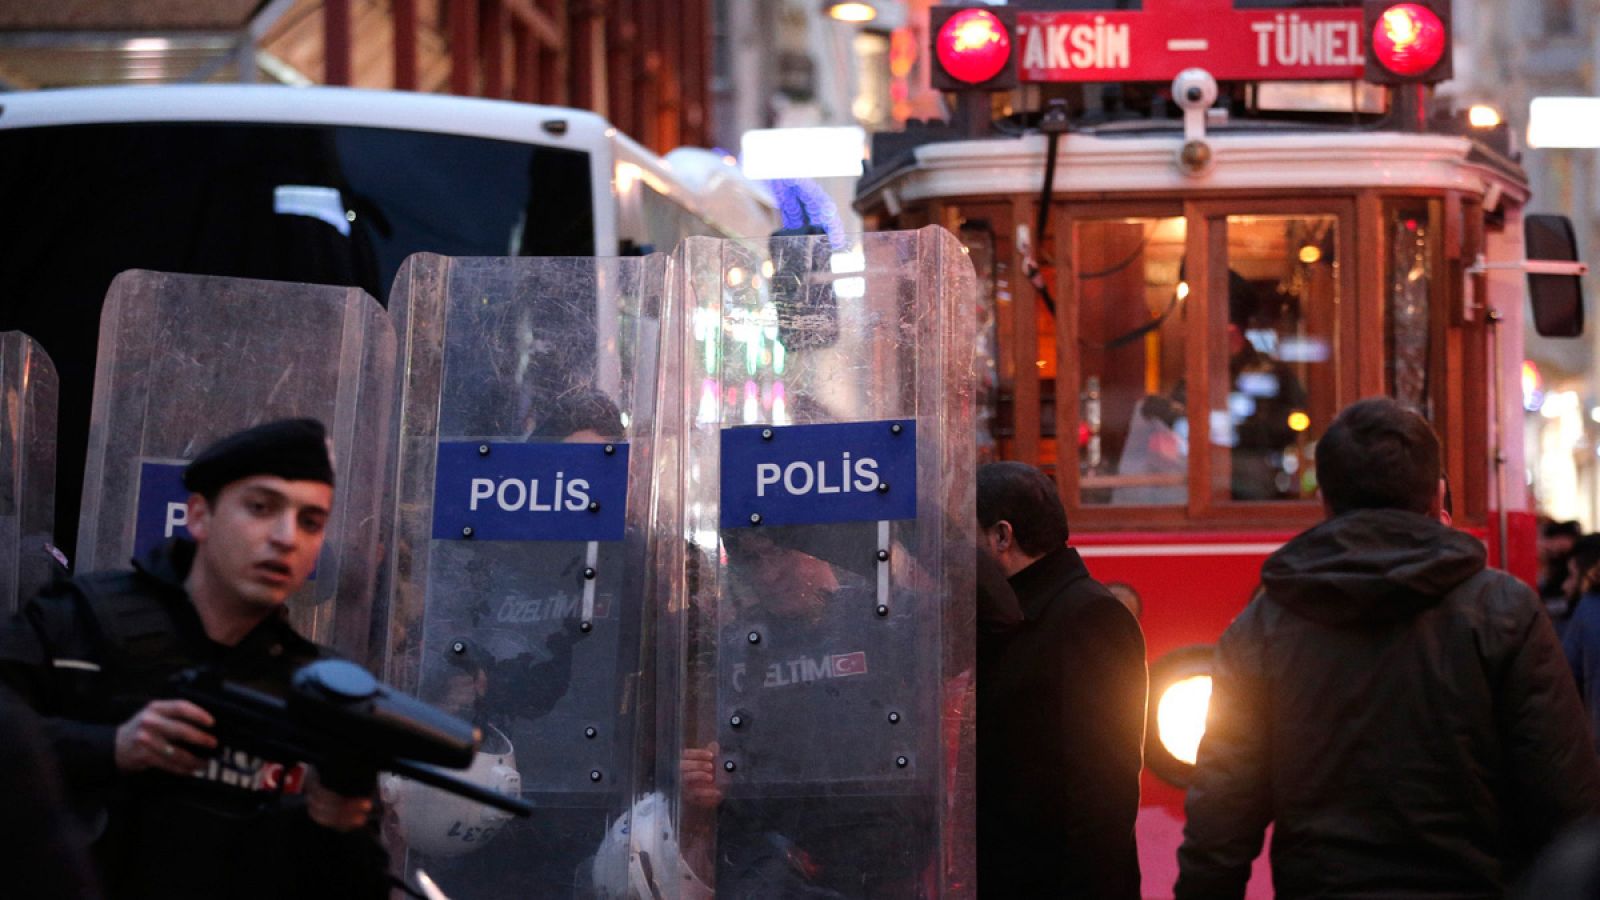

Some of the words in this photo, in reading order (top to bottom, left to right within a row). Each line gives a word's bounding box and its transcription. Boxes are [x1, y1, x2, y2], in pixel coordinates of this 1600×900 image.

[1016, 18, 1129, 69] AKSİM
[1252, 16, 1365, 67] TÜNEL
[470, 472, 590, 512] POLİS
[756, 453, 880, 497] POLİS
[732, 654, 832, 692] ÖELTİM
